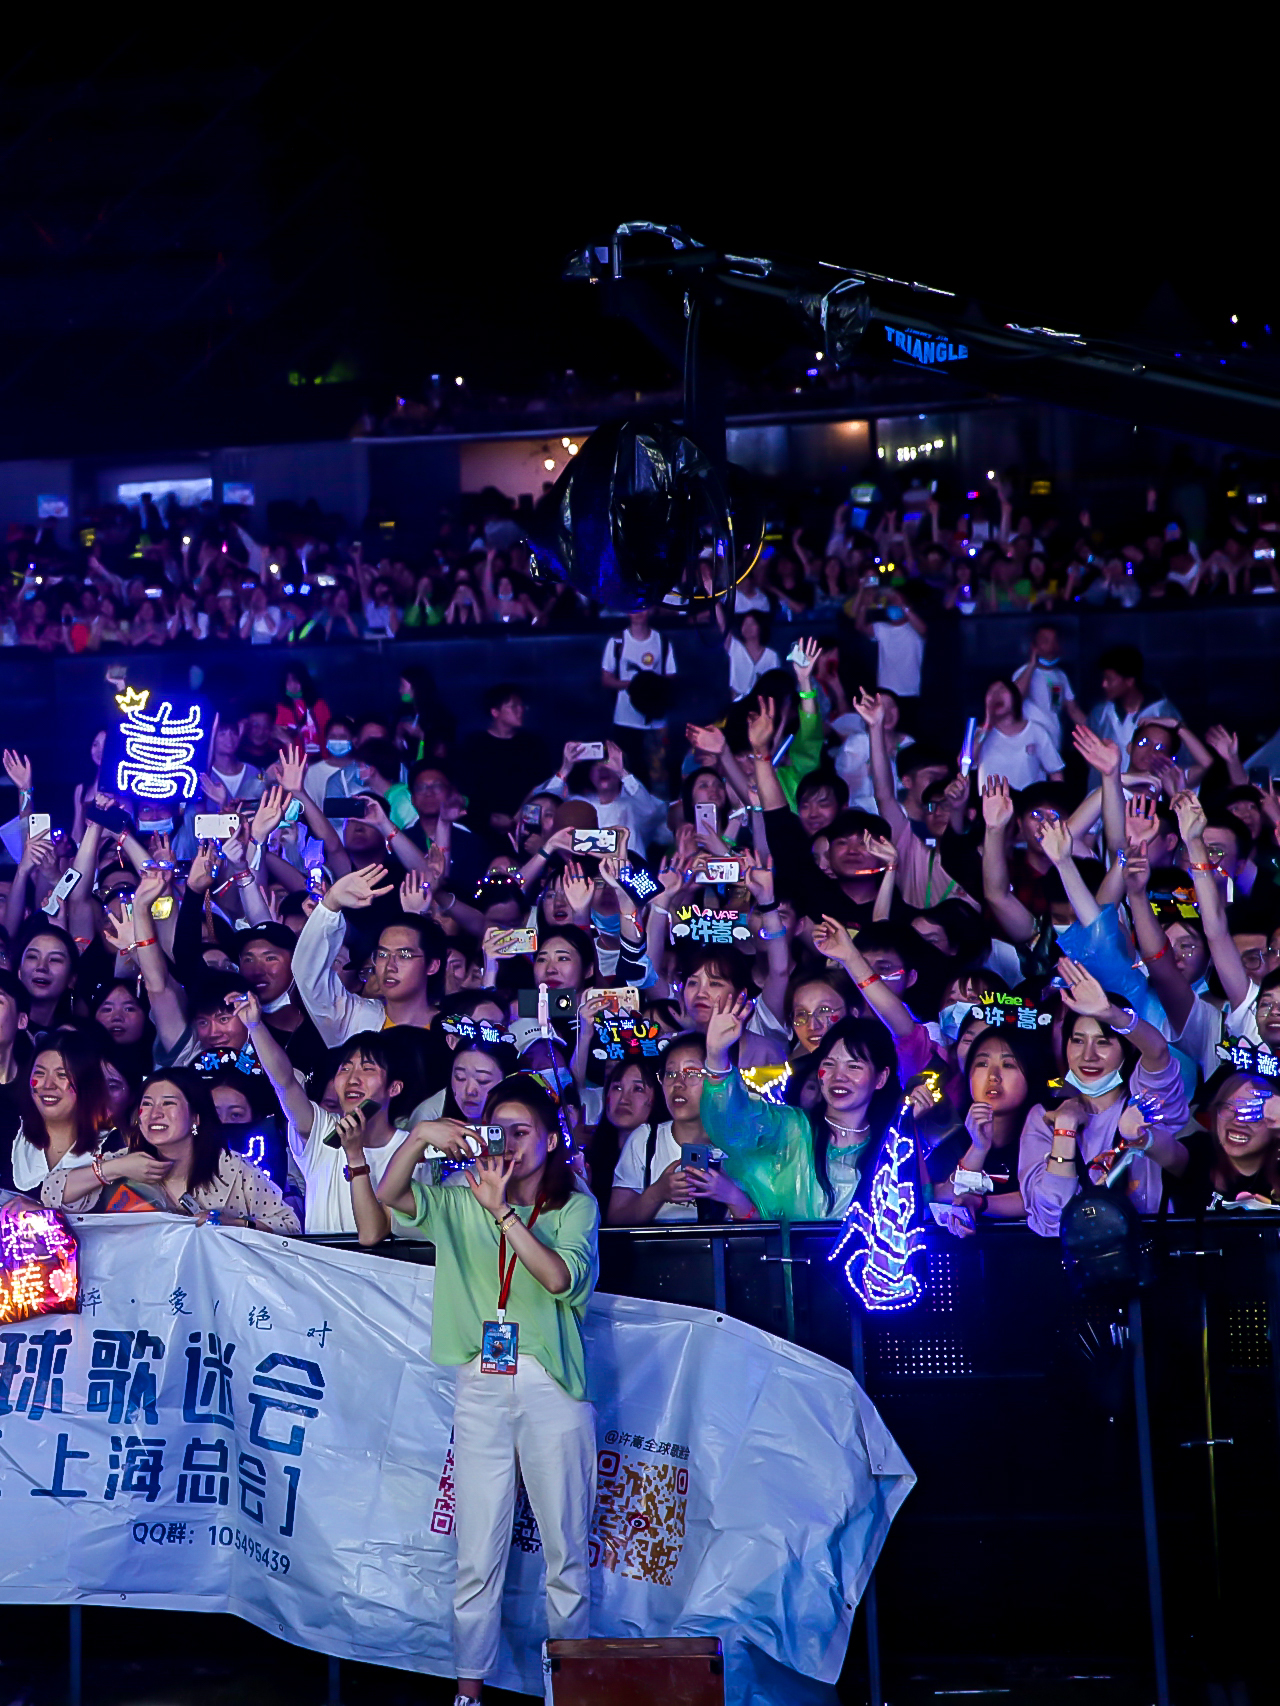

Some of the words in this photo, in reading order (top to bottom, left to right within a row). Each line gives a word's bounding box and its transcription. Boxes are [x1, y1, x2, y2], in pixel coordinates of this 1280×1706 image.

[884, 325, 968, 364] TRIANGLE
[117, 701, 204, 799] 嵩
[690, 919, 733, 944] 许嵩
[996, 992, 1023, 1006] Vae
[984, 1006, 1037, 1030] 许嵩
[1231, 1047, 1278, 1077] 许嵩
